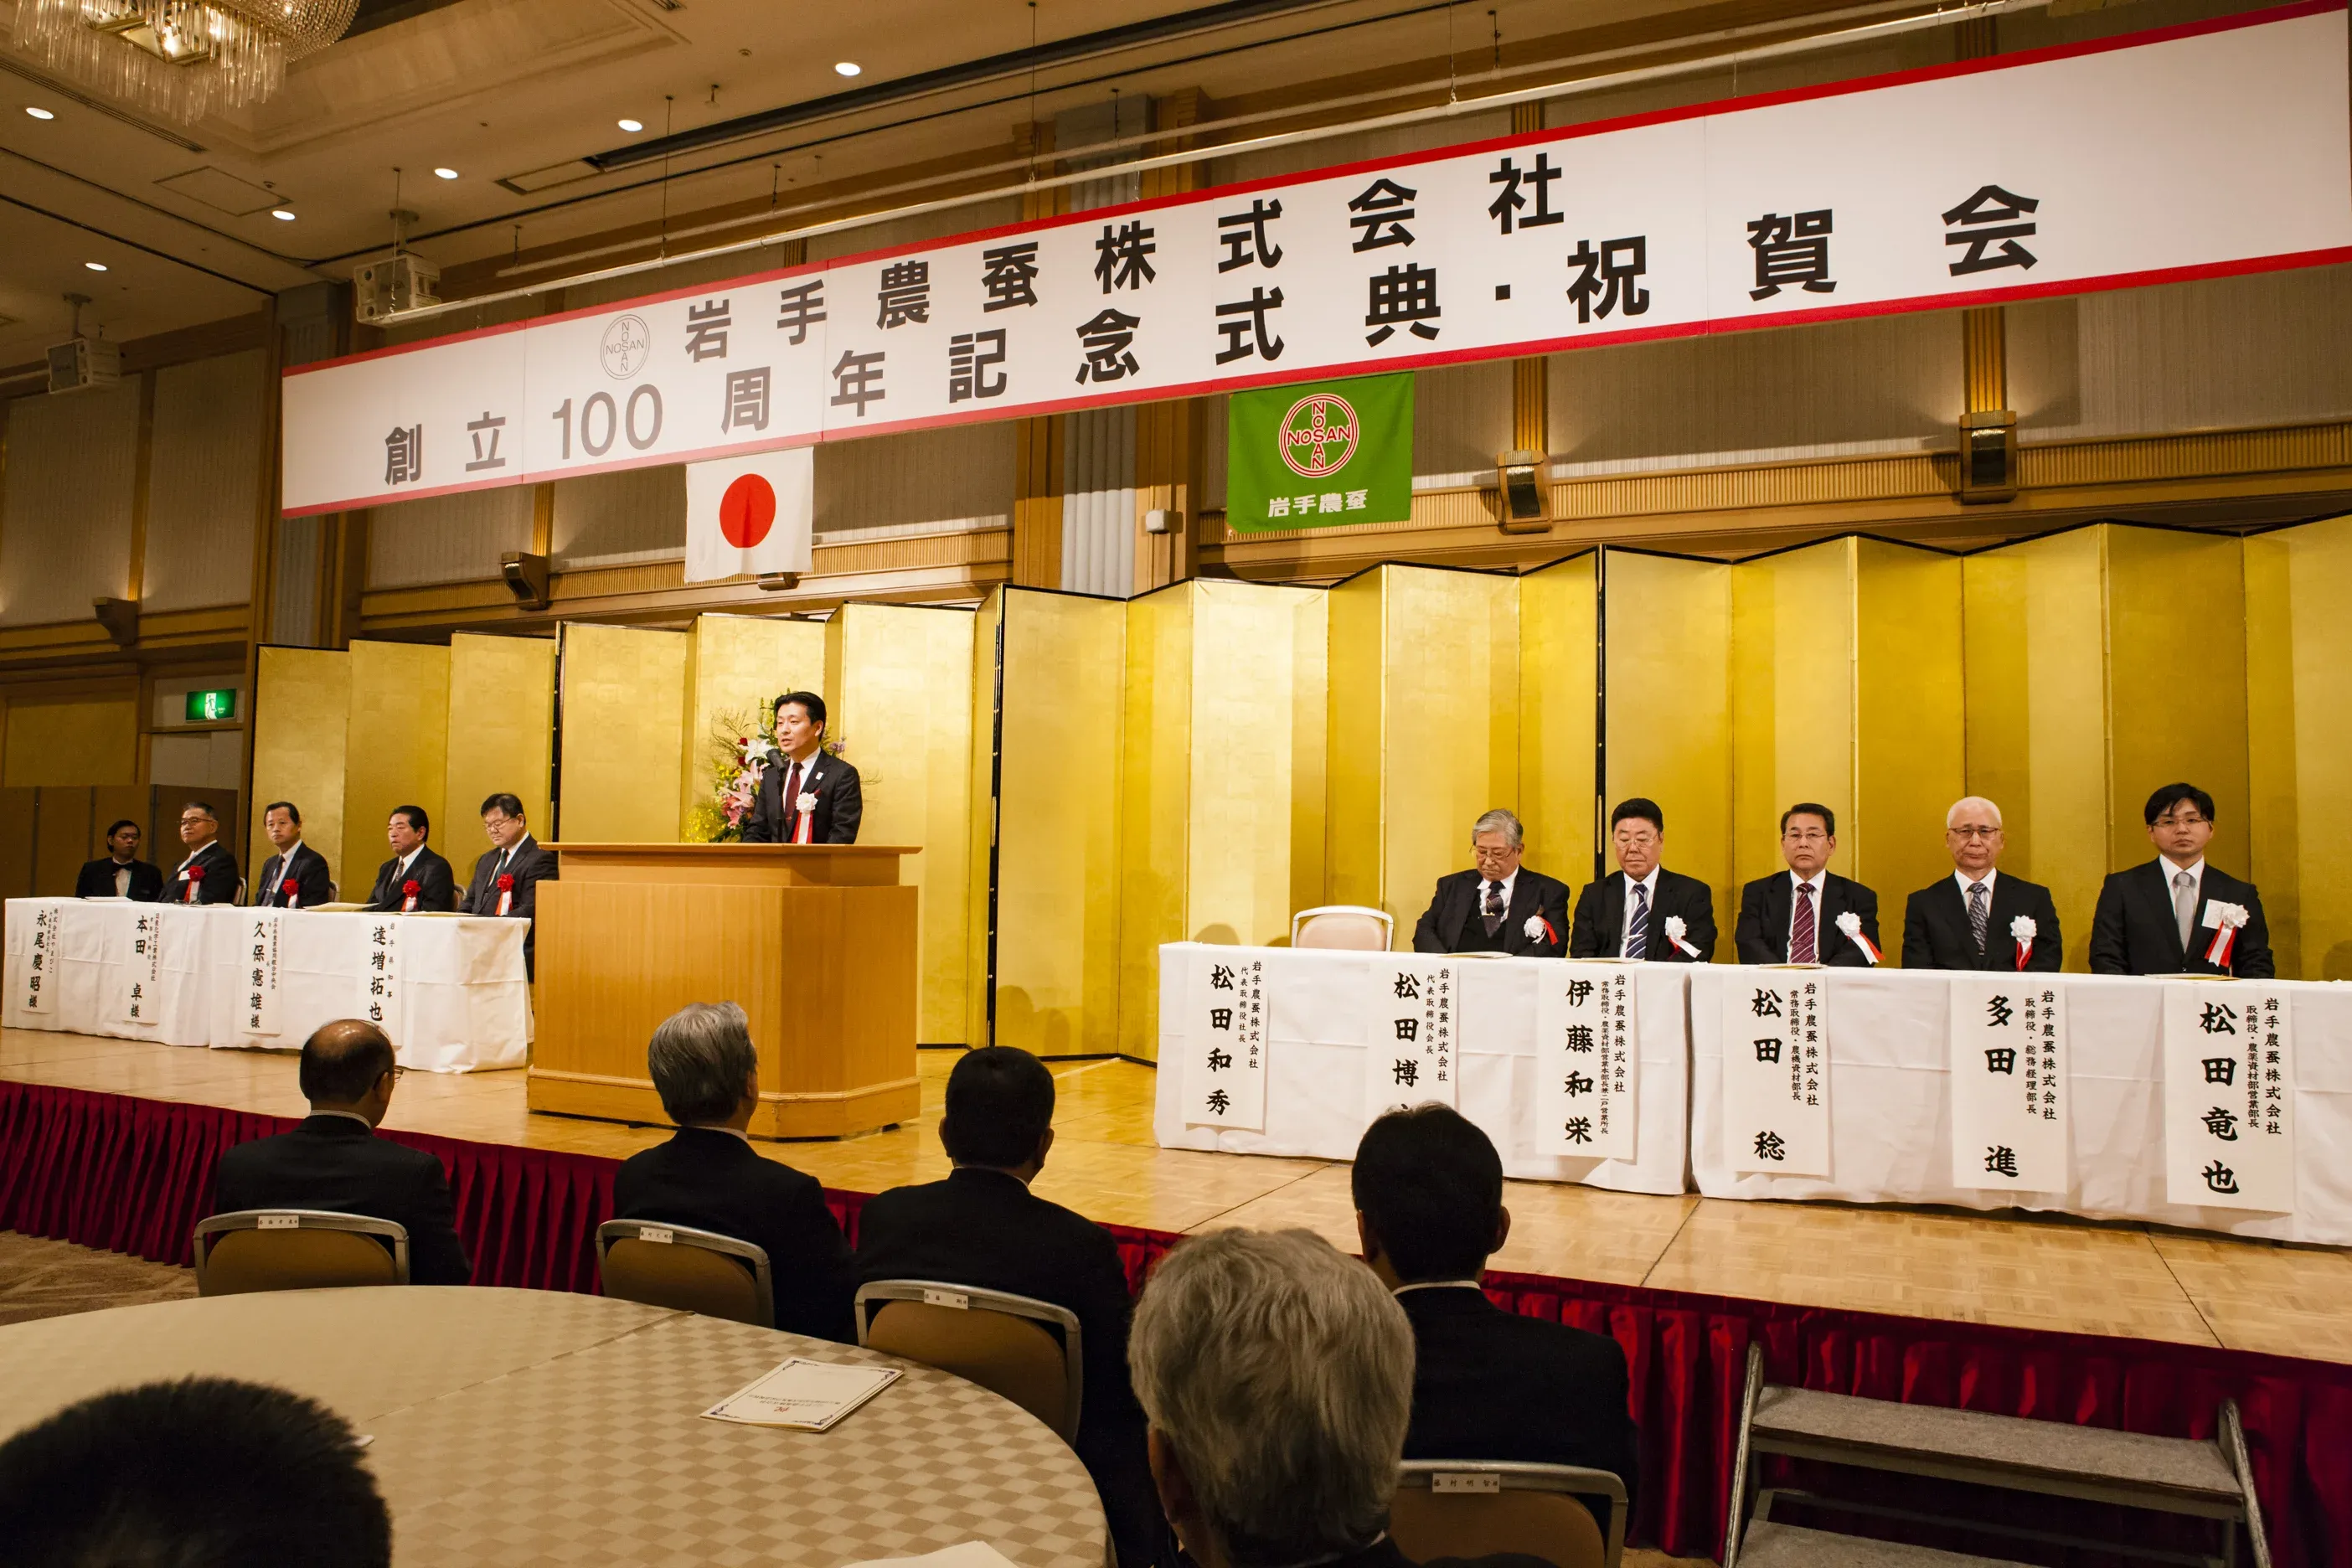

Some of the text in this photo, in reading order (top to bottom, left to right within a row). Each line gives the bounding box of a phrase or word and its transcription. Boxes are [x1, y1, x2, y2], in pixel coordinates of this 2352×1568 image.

[685, 152, 1565, 363] 岩手農蚕株式会社
[606, 338, 644, 355] NOSAN
[1287, 425, 1351, 446] NOSAN
[1268, 488, 1369, 518] 岩手農蚕
[28, 909, 47, 1008] 永尾慶昭様
[250, 920, 266, 1029] 久保憲雄様
[369, 925, 387, 1021] 達増拓也
[1238, 967, 1249, 1043] 代表取締役社長
[1249, 960, 1261, 1069] 岩手農蚕株式会社
[1426, 974, 1436, 1055] 代表取締役会長
[1205, 963, 1235, 1116] 松田和秀
[1392, 972, 1421, 1110] 松田博
[1437, 967, 1450, 1082] 岩手農蚕株式会社
[1564, 978, 1595, 1145] 伊藤和栄
[1613, 974, 1626, 1093] 岩手農蚕株式会社
[1804, 982, 1819, 1106] 岩手農蚕株式会社
[2024, 997, 2037, 1115] 取締役・総務経理部長
[2040, 990, 2057, 1121] 岩手農蚕株式会社
[2264, 997, 2282, 1135] 岩手農蚕株式会社
[2200, 1001, 2240, 1195] 松田竜也
